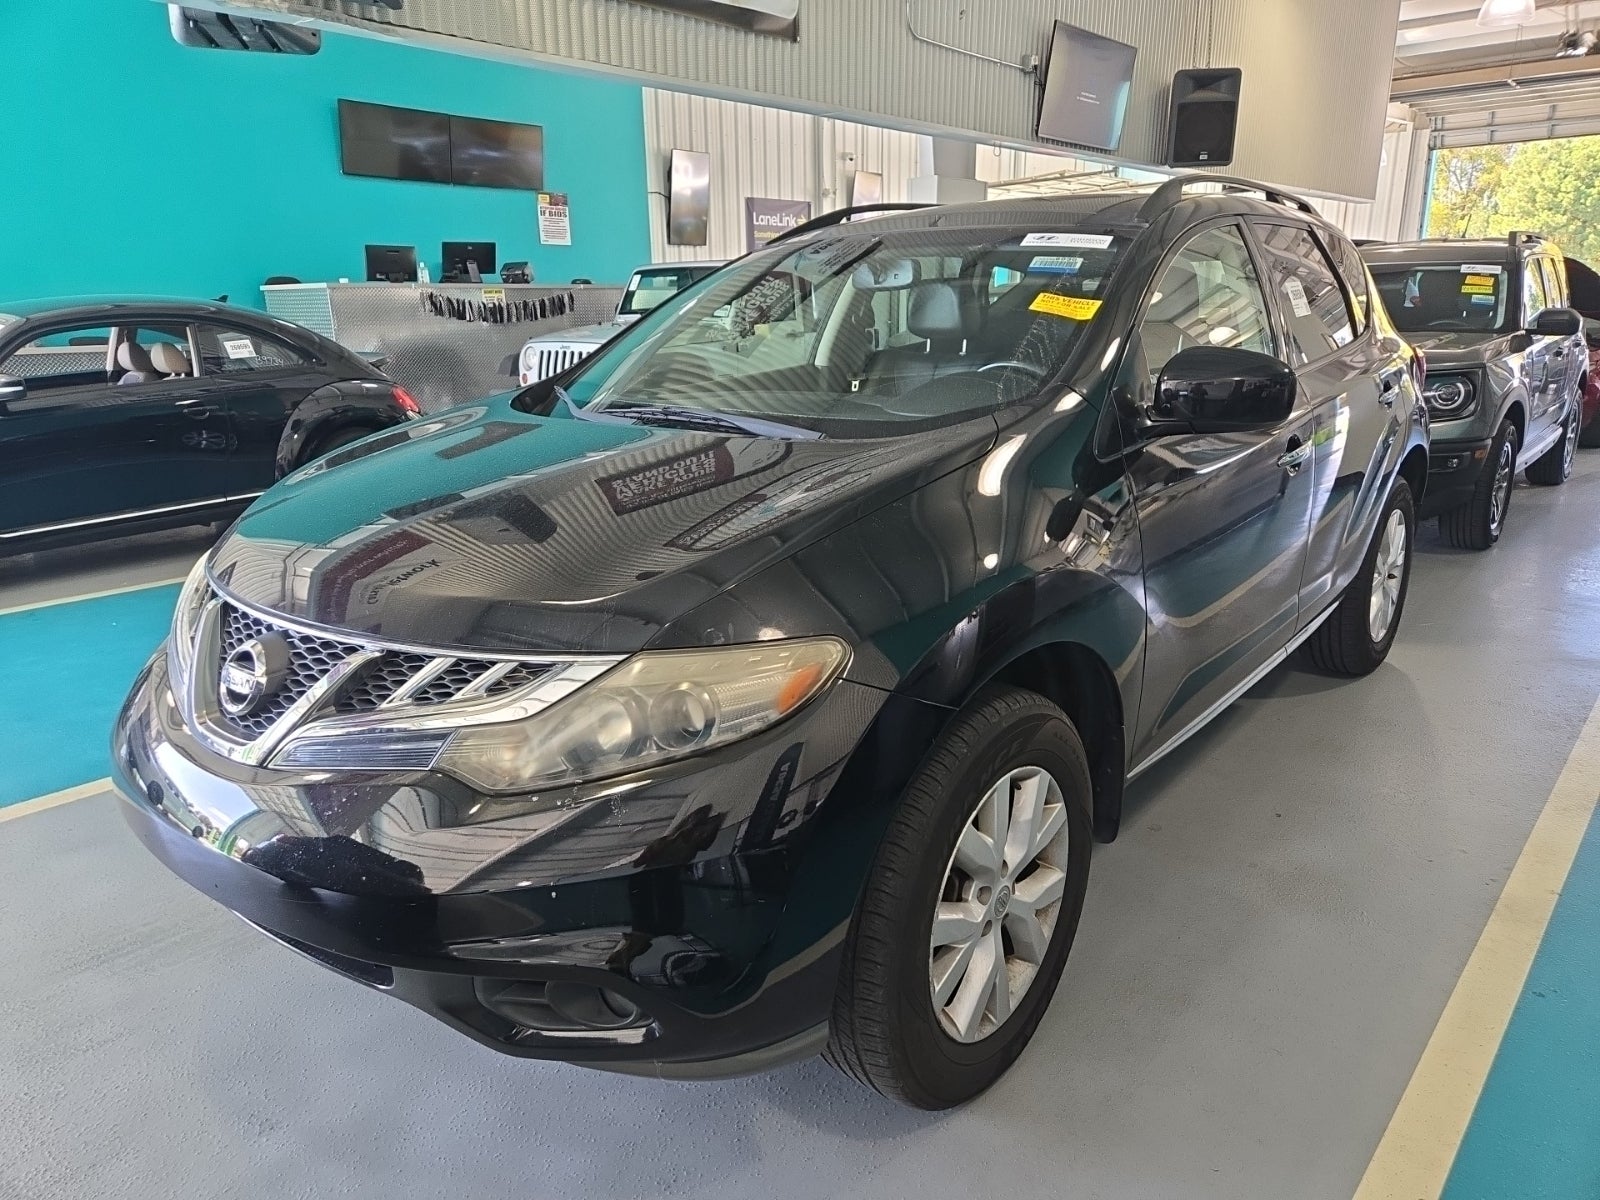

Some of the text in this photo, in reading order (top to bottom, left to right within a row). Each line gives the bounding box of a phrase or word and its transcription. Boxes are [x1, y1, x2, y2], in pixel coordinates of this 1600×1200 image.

[753, 211, 797, 228] LaneLink
[1042, 294, 1097, 307] THIS VEHICLE
